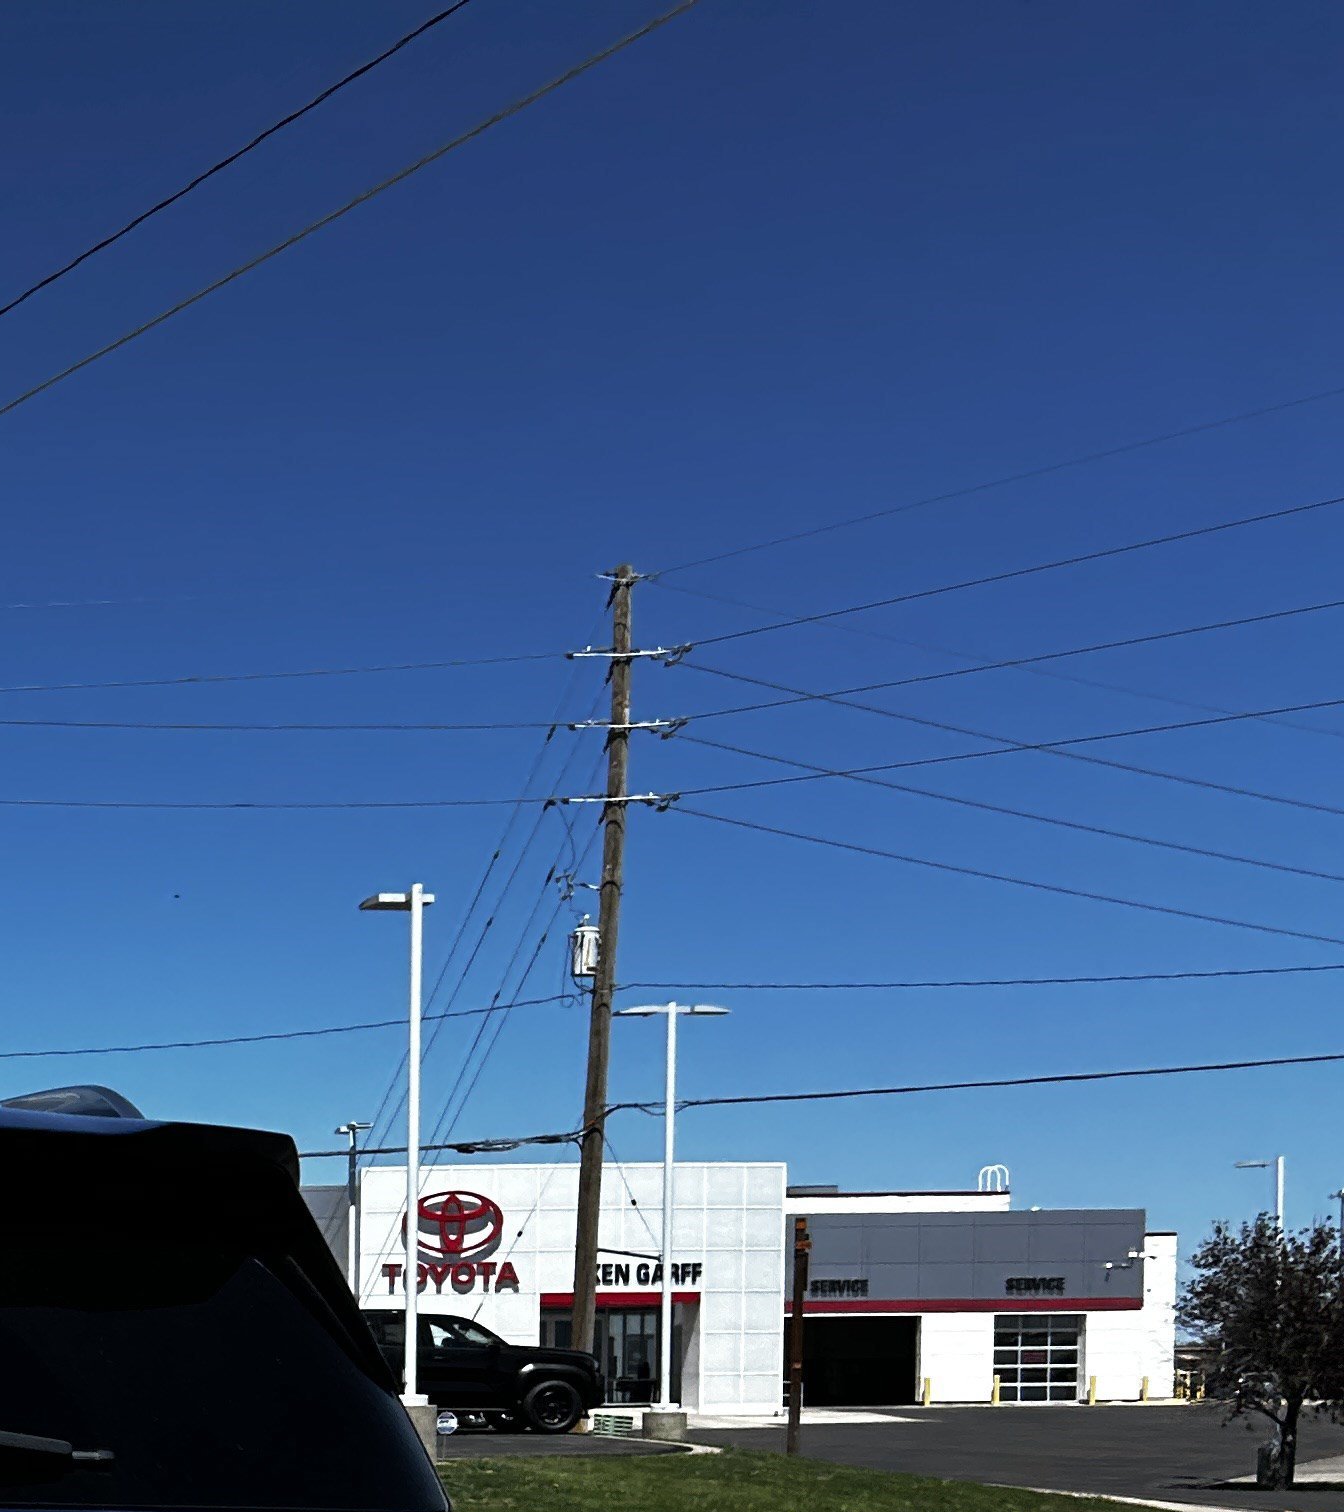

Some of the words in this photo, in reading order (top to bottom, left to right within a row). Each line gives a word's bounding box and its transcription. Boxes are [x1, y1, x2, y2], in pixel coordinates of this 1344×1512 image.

[381, 1261, 520, 1295] TOYOTA
[636, 1262, 703, 1286] GARFF
[810, 1278, 869, 1298] SERVICE
[1005, 1276, 1066, 1296] SERVICE
